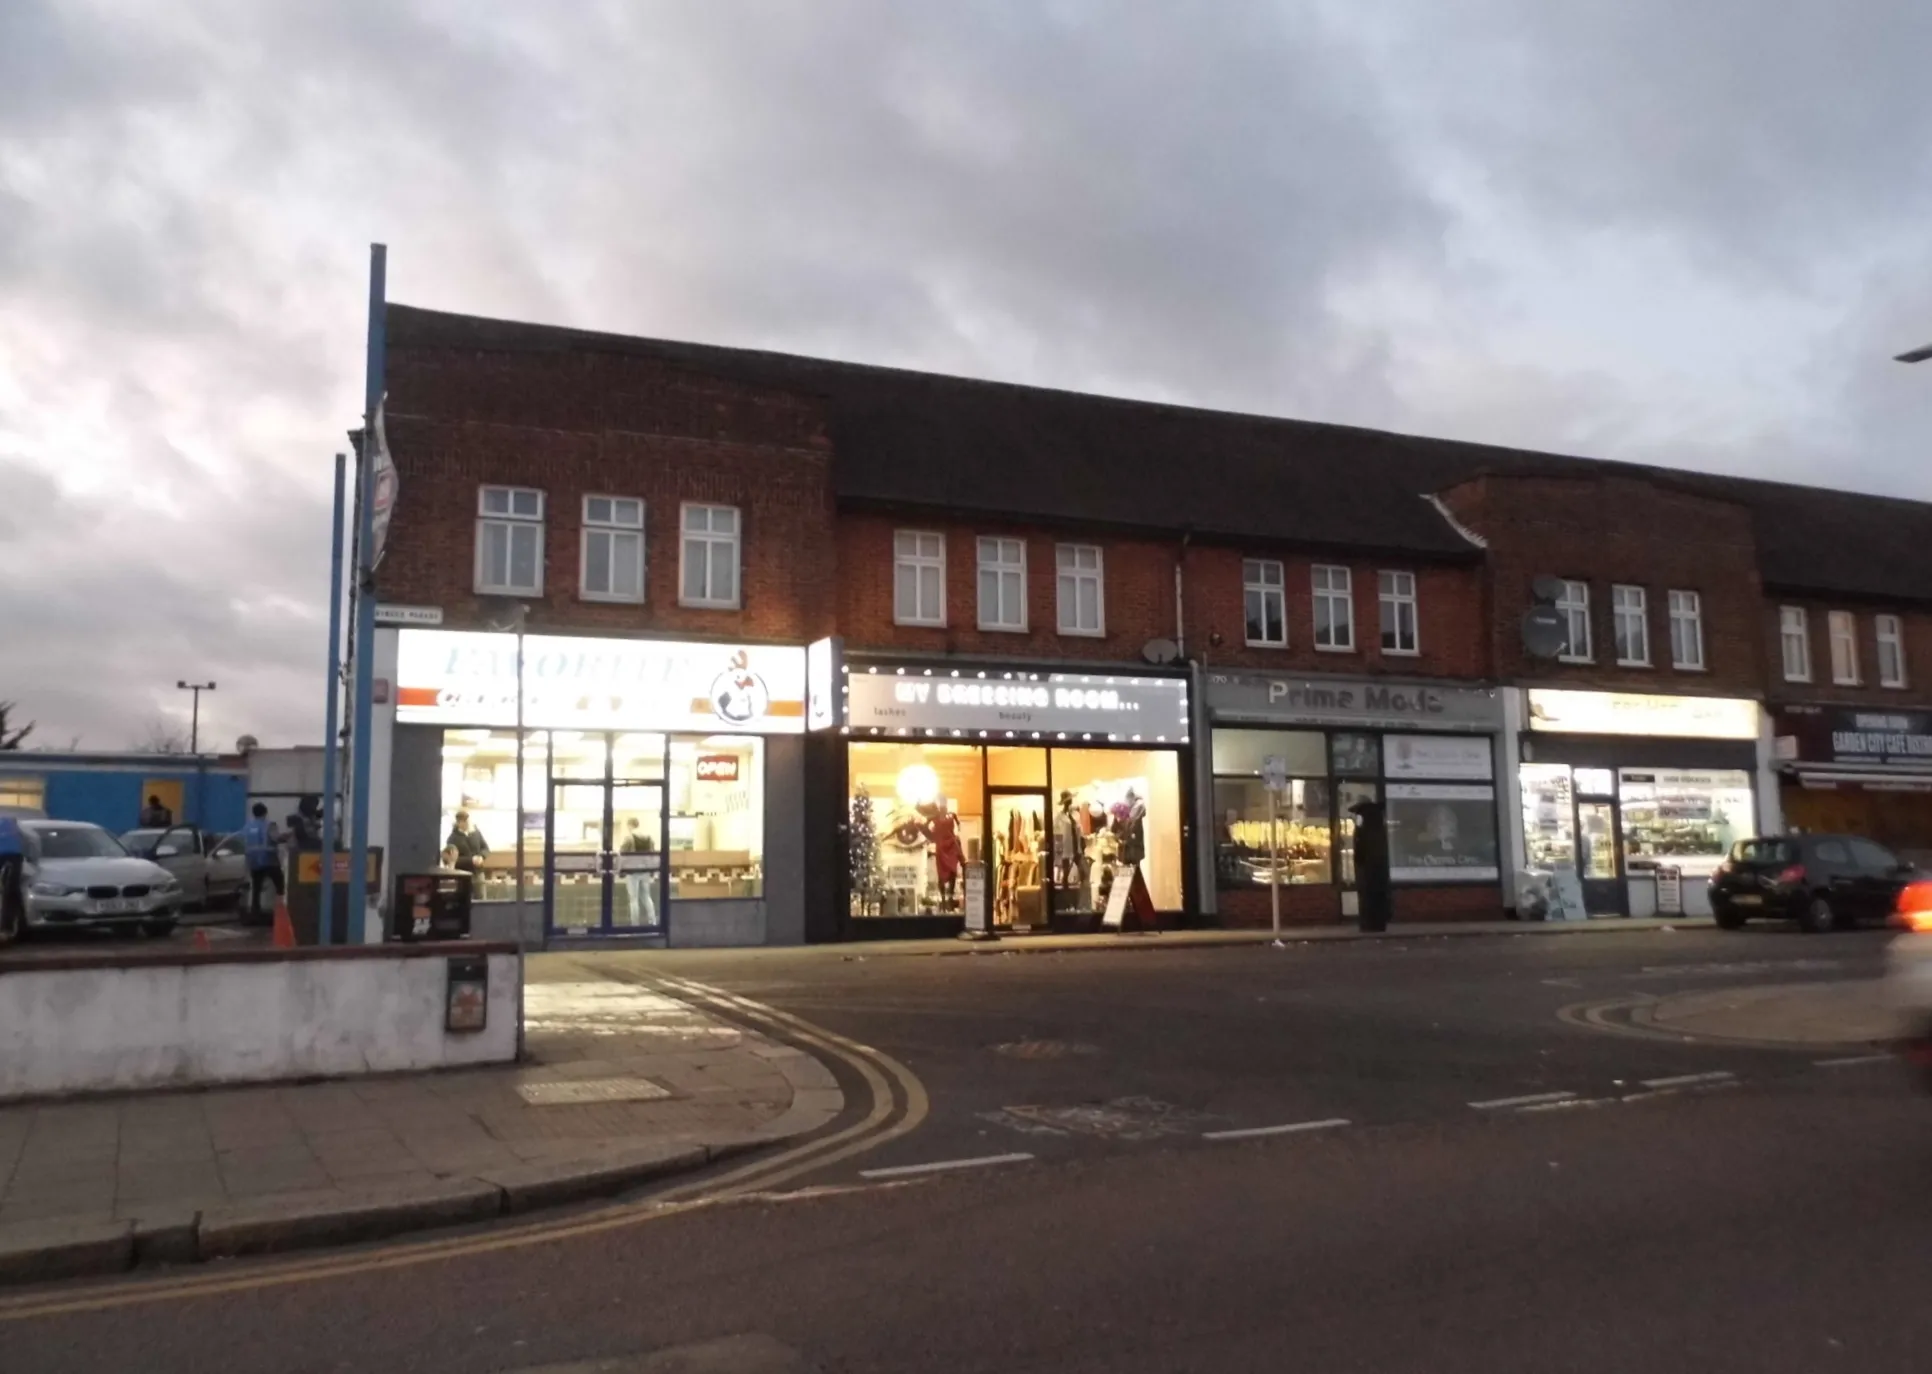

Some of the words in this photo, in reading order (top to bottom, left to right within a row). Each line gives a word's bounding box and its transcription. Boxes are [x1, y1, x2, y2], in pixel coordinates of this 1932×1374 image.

[1268, 681, 1354, 710] Prime
[998, 711, 1032, 723] beauty
[697, 760, 738, 777] OPEN
